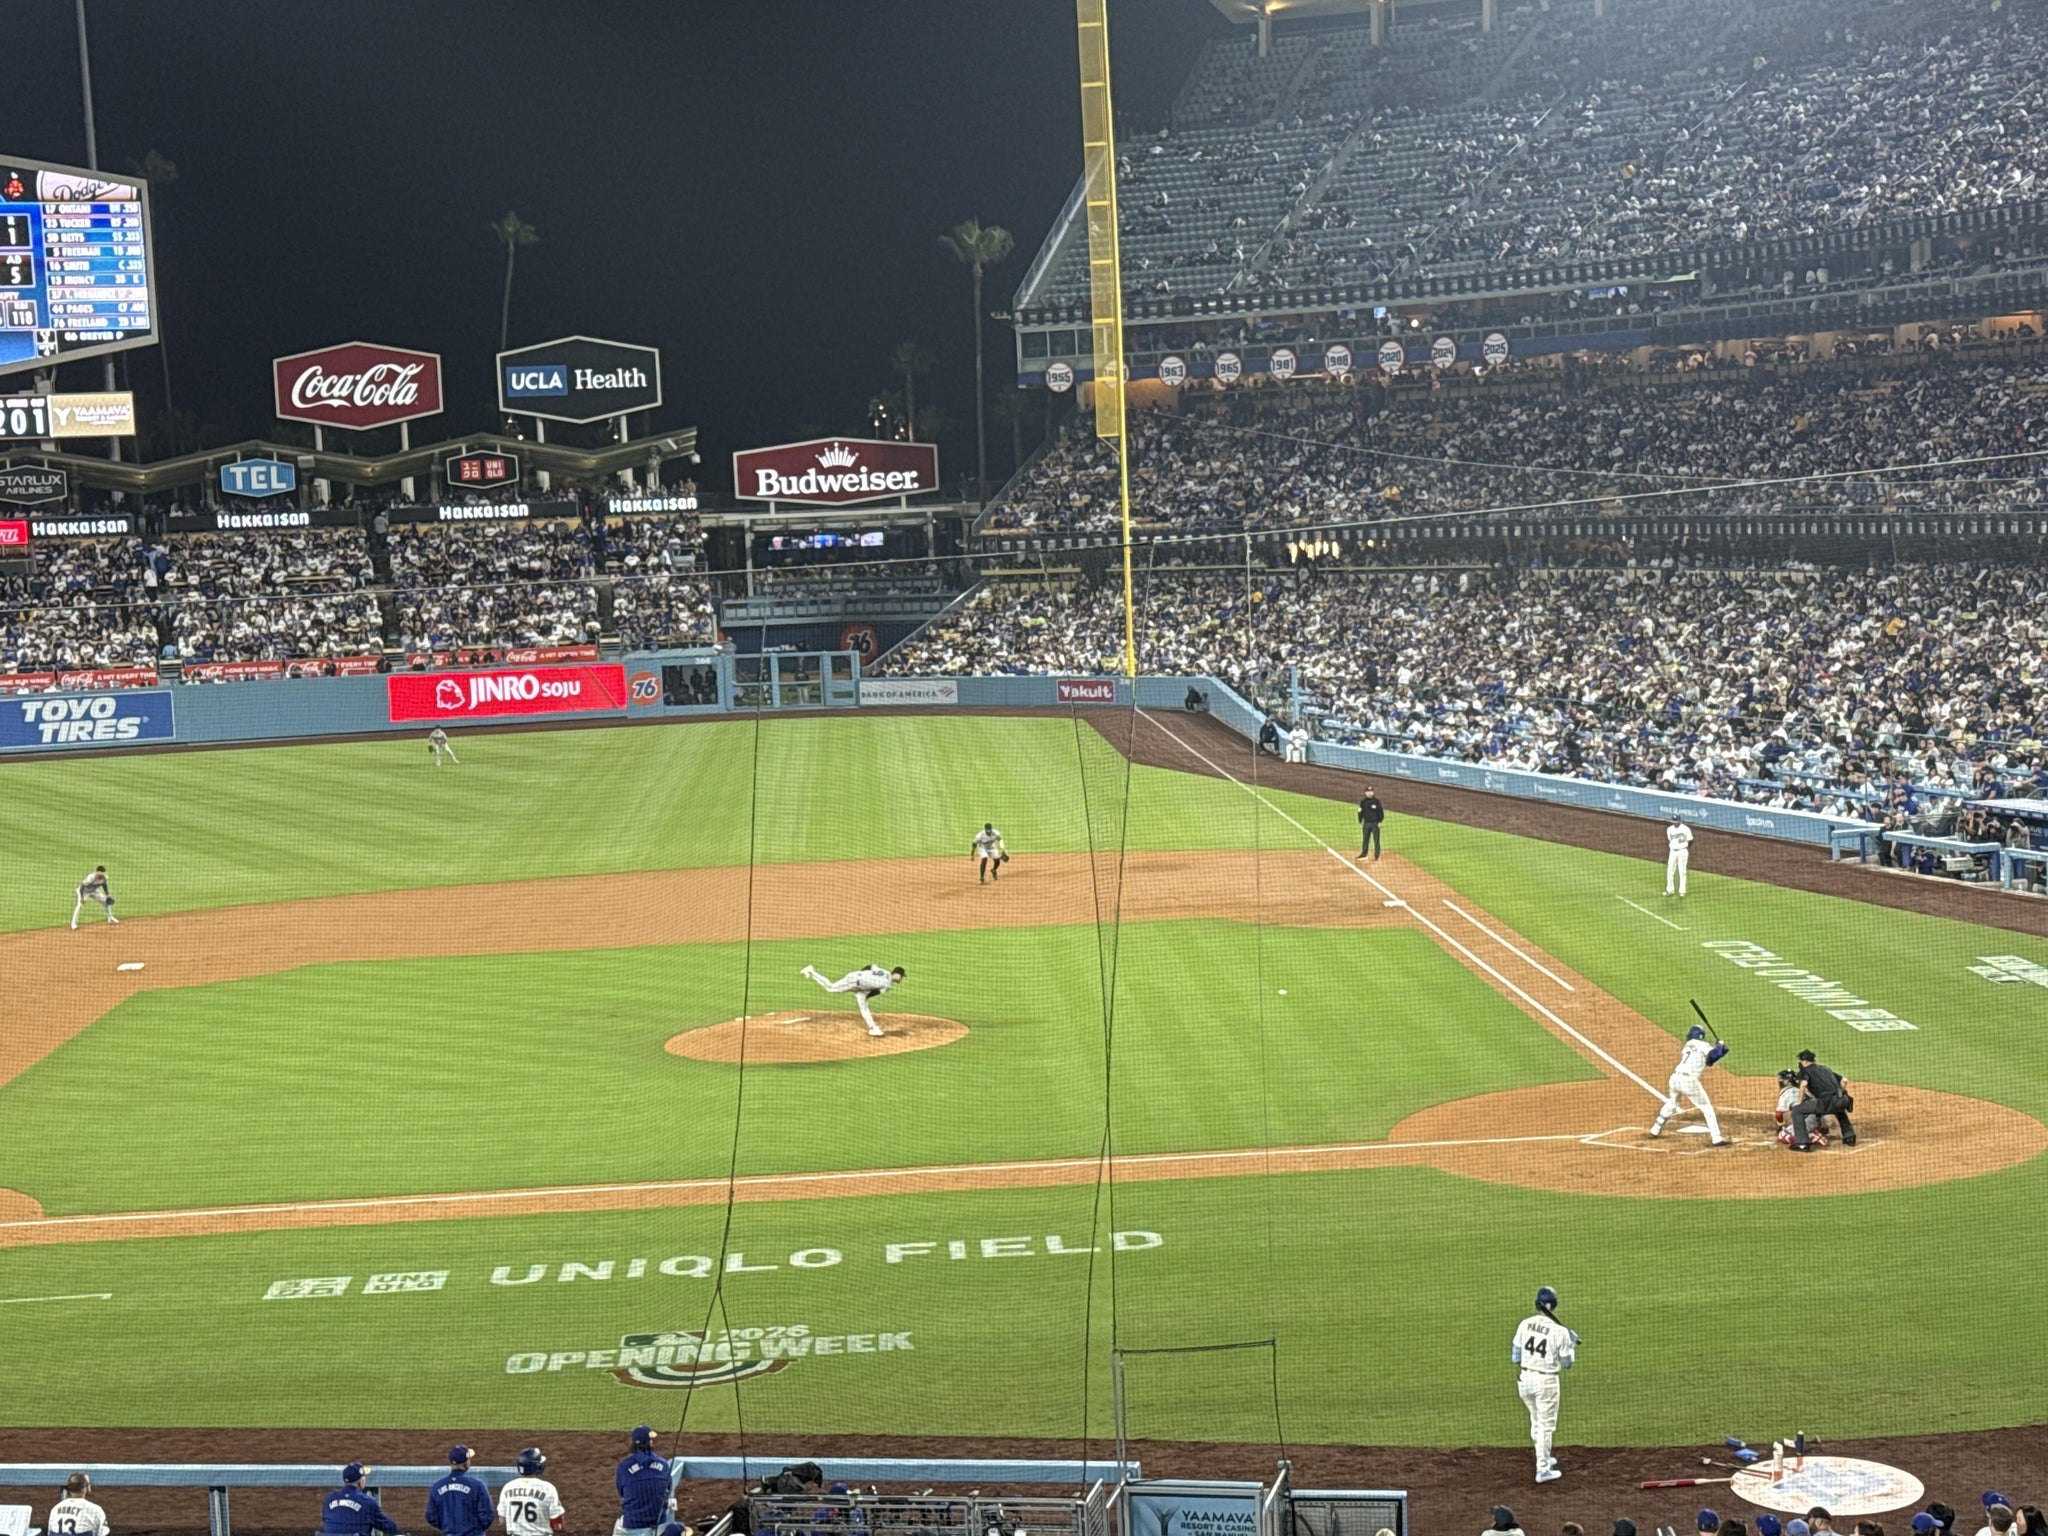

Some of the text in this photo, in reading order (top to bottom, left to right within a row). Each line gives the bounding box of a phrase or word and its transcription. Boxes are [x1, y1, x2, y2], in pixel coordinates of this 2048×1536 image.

[6, 255, 22, 265] AB
[11, 266, 21, 284] 5
[1432, 347, 1454, 359] 2024
[1483, 344, 1506, 355] 2025
[1327, 355, 1349, 366] 1988
[1379, 351, 1401, 362] 2020
[1160, 365, 1184, 377] 1963
[1216, 362, 1239, 373] 1965
[1271, 359, 1294, 370] 1981
[511, 368, 648, 390] UCLA Health
[1047, 372, 1071, 383] 1955
[292, 363, 424, 408] Coca-Cola
[486, 461, 502, 469] UNI
[229, 466, 287, 490] TEL
[487, 469, 503, 479] QLO
[5, 486, 53, 495] AIRLINES
[467, 675, 540, 710] JINRO
[632, 678, 657, 699] 76
[886, 690, 897, 698] OF
[900, 690, 938, 698] AMERICA
[1059, 685, 1113, 698] Yakult
[21, 697, 117, 723] TOYO
[38, 717, 141, 743] TIRES
[490, 1230, 1164, 1285] UNIQLO FIELD
[718, 1324, 810, 1342] 2026
[505, 1331, 916, 1375] OPENING WEEK
[1524, 1336, 1548, 1359] 44
[504, 1487, 547, 1501] FREELAND
[510, 1501, 538, 1523] 76
[58, 1518, 77, 1535] 13
[1181, 1522, 1214, 1530] RESORT
[1225, 1524, 1257, 1533] CASINO
